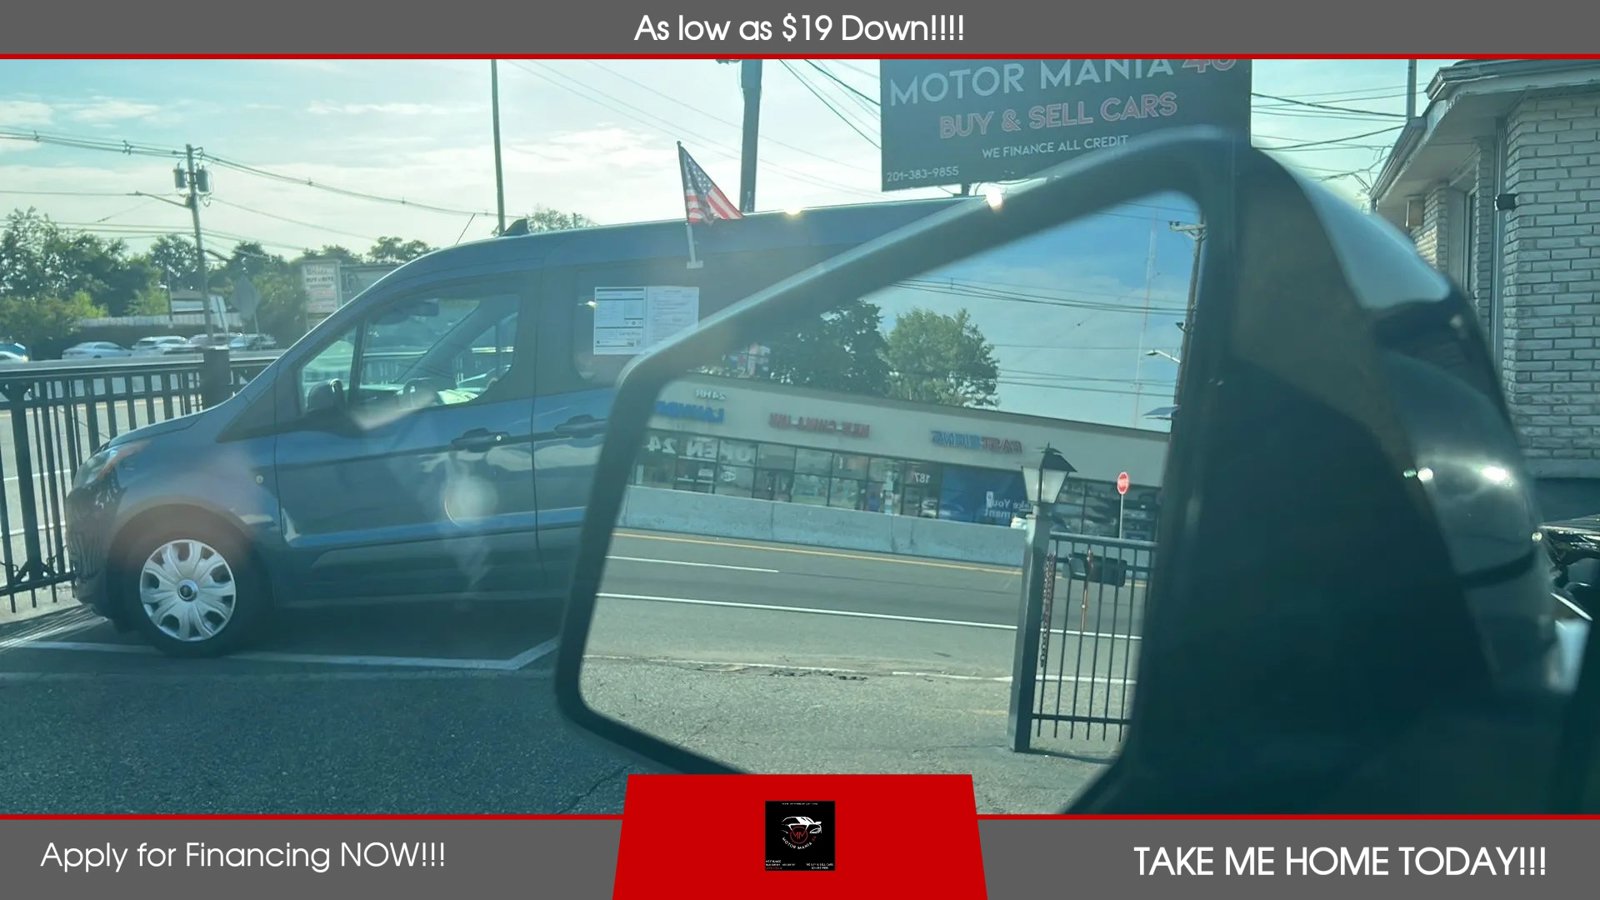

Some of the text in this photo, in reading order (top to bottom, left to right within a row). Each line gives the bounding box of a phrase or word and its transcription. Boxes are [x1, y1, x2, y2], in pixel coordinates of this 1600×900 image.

[889, 61, 1025, 107] MOTOR
[1040, 58, 1174, 90] MANIA
[939, 91, 1178, 139] BUY & SELL CARS
[982, 134, 1129, 159] WE FINANCE ALL CREDIT
[886, 165, 960, 183] 201-383-9855
